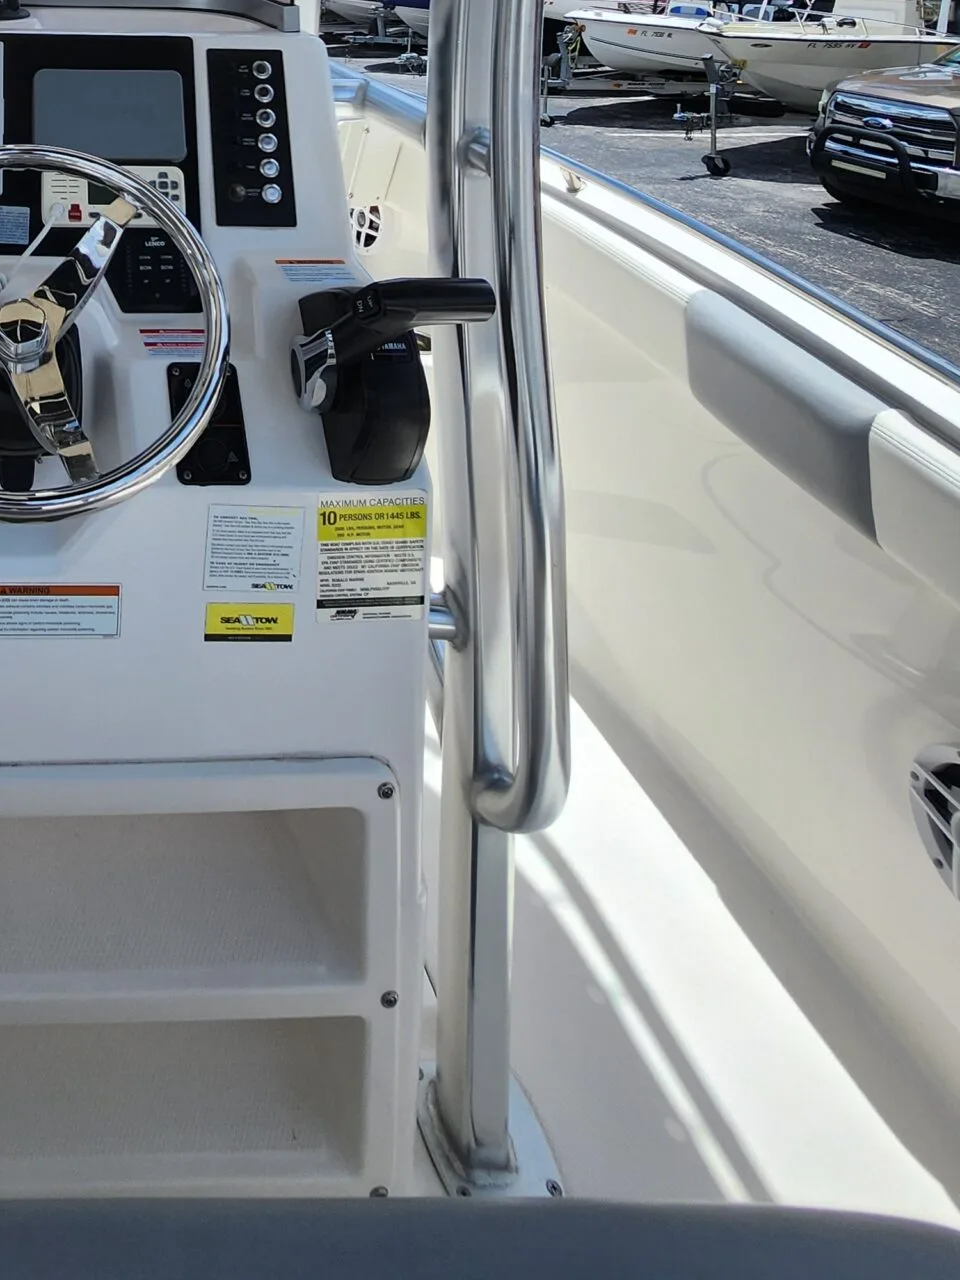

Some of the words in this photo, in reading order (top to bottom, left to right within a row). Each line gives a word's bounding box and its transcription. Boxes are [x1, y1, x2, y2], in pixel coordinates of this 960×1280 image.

[320, 499, 367, 508] MAXIMUM
[369, 497, 425, 507] CAPACITIES
[320, 510, 337, 526] 10
[339, 512, 372, 521] PERSONS
[374, 512, 385, 520] OR
[9, 587, 50, 595] WARNING
[220, 616, 240, 624] SEA
[253, 616, 278, 624] TOW
